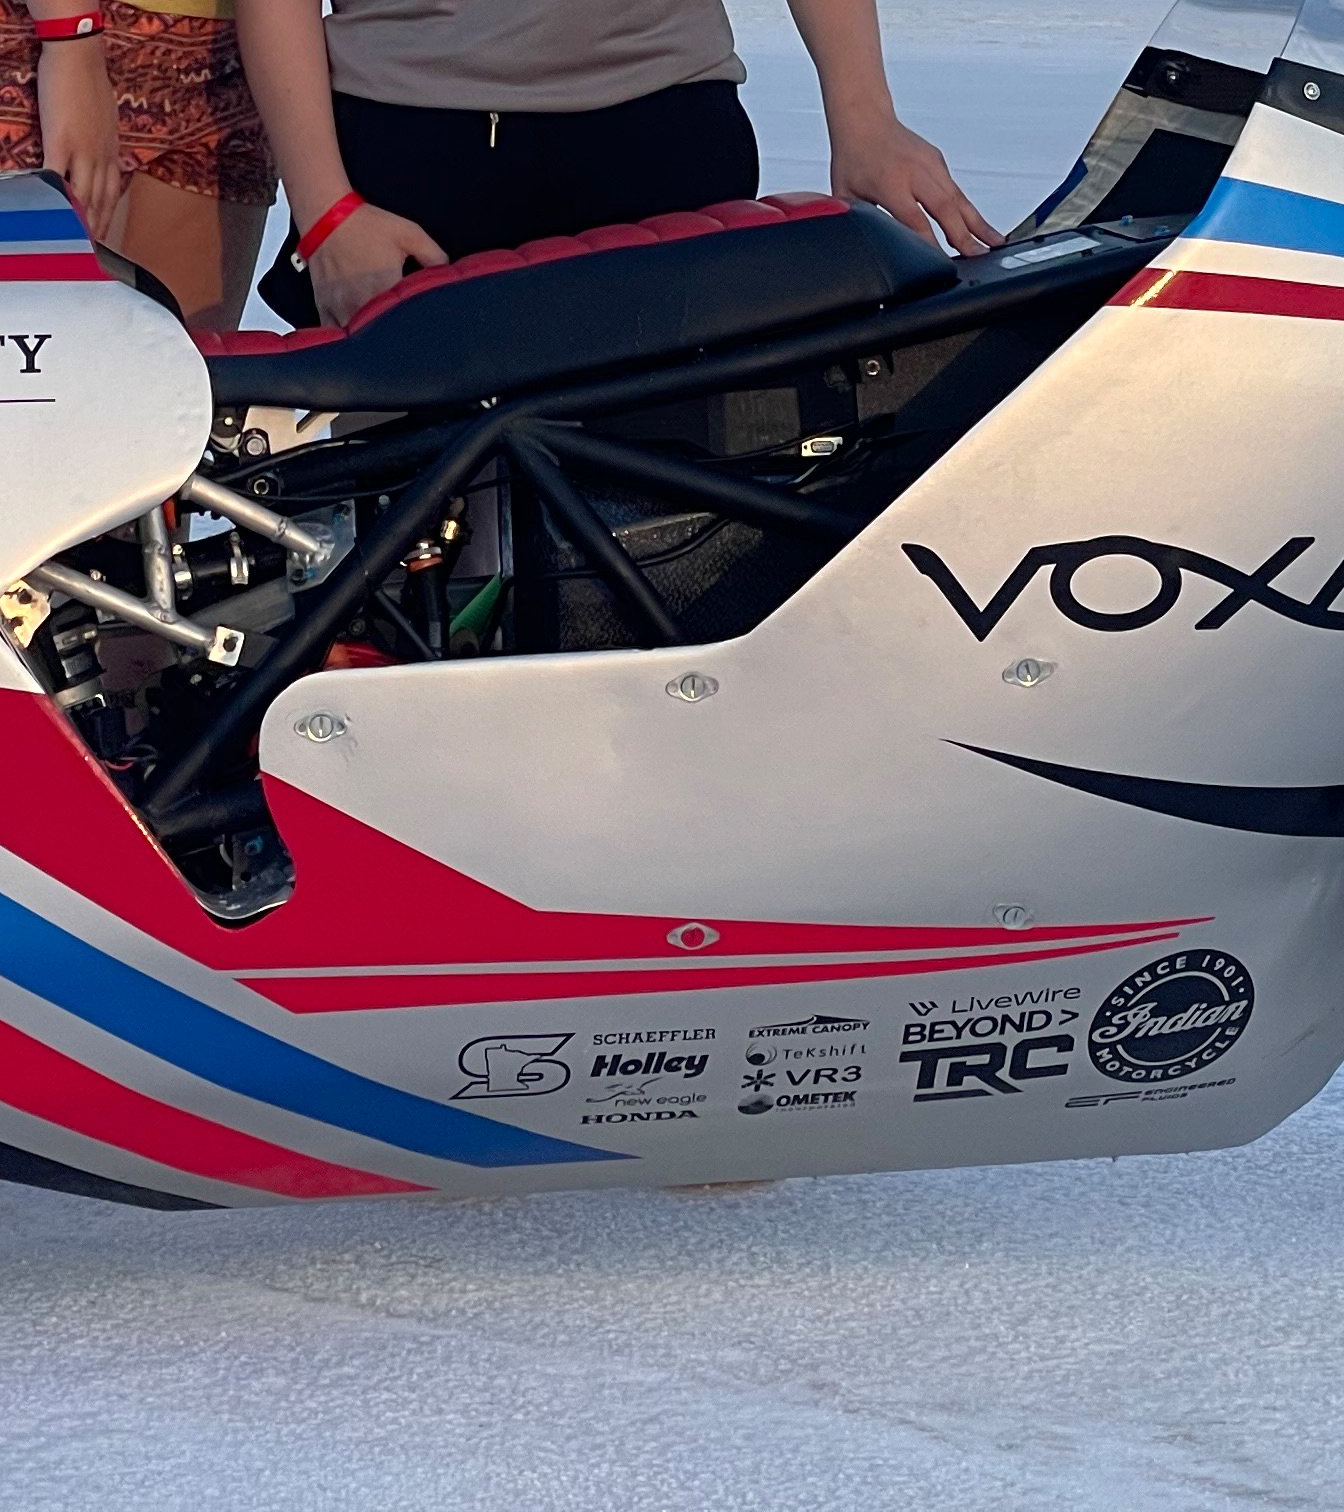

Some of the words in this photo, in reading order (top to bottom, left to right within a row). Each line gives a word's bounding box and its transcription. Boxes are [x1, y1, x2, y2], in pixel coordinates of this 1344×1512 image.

[1111, 956, 1187, 1007] SINCE
[1201, 954, 1244, 987] 1901
[952, 987, 1081, 1014] LiveWire
[749, 1026, 807, 1038] EXTREME
[812, 1021, 871, 1034] CANOPY
[1091, 999, 1249, 1043] Indian
[593, 1028, 716, 1046] SCHAEFFLER
[590, 1051, 709, 1079] Holley
[899, 1034, 1075, 1094] TRC
[1096, 1026, 1240, 1080] MOTORCYCLE
[786, 1065, 862, 1086] VR3
[614, 1098, 652, 1108] new
[656, 1091, 708, 1107] eagle
[776, 1090, 858, 1107] OMETEK
[580, 1110, 699, 1125] HONDA
